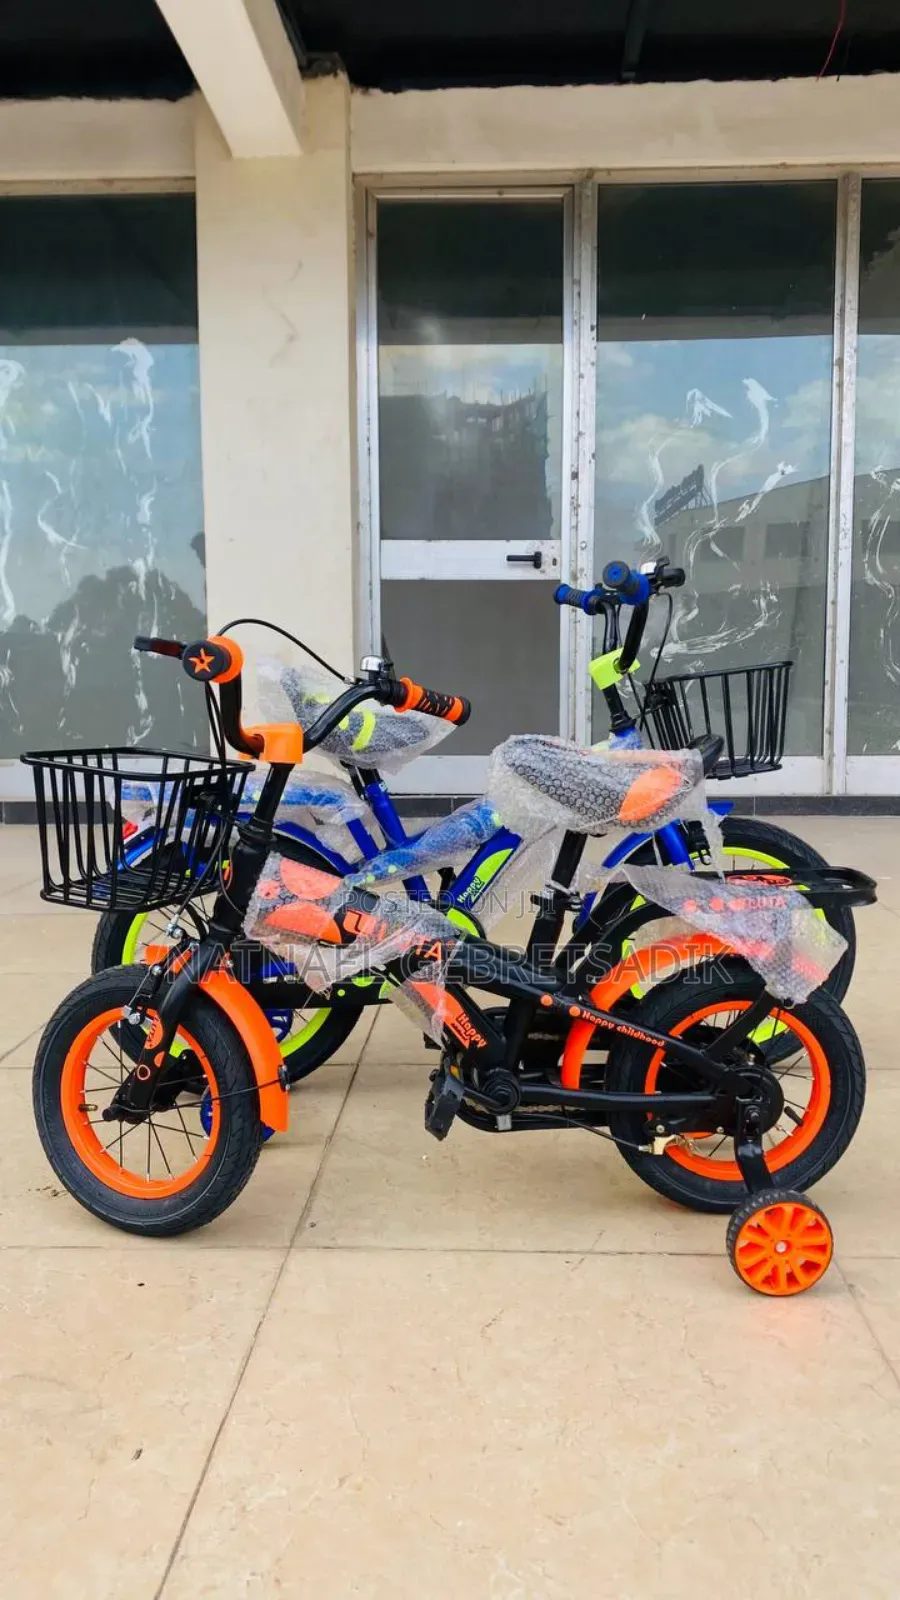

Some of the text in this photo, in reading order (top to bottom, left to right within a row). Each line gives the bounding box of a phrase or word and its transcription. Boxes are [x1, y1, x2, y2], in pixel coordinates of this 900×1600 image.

[457, 1012, 488, 1049] Happy
[582, 1009, 666, 1048] Happy childhood
